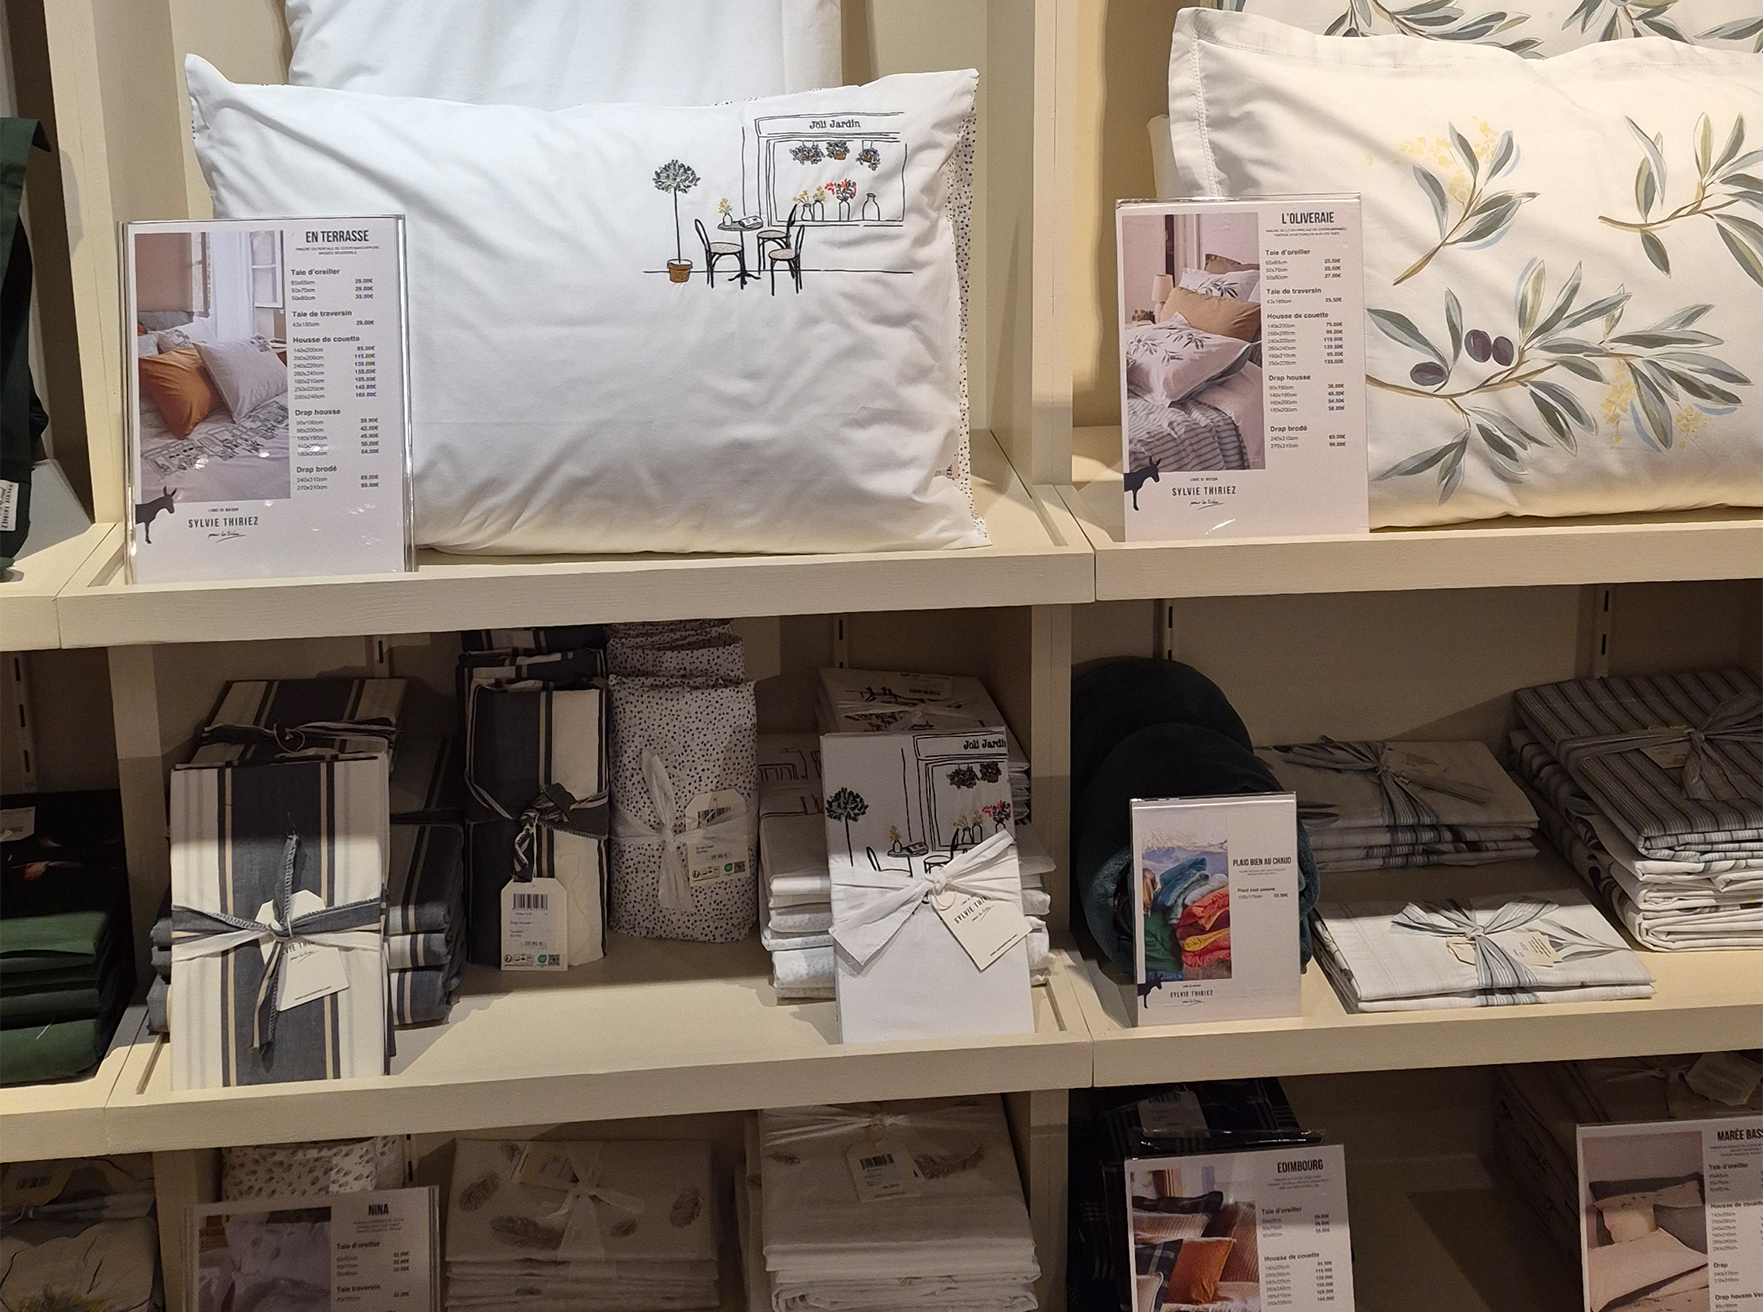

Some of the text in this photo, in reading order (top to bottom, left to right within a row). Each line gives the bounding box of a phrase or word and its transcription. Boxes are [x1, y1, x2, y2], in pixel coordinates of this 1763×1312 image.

[809, 119, 861, 129] Joli Jardin
[1281, 211, 1334, 224] L'OLIVERAIE
[305, 229, 369, 243] EN TERRASSE
[308, 268, 340, 276] d'oreiller
[320, 309, 352, 317] traversin
[293, 336, 320, 344] Housse
[333, 335, 360, 343] couette
[314, 408, 341, 416] housse
[296, 465, 337, 474] Drap brodé
[1172, 485, 1236, 497] SYLVIE THIRIEZ
[188, 516, 259, 528] SYLVIE THIRIEZ
[963, 739, 980, 750] Joli
[1232, 856, 1292, 867] PLAID BIEN AU CHAUD
[953, 906, 974, 924] SYLVIE
[973, 895, 986, 908] THI
[1717, 1128, 1763, 1141] MARÉE BAS
[1277, 1159, 1324, 1173] EDIMBOURG
[368, 1203, 389, 1216] NINA
